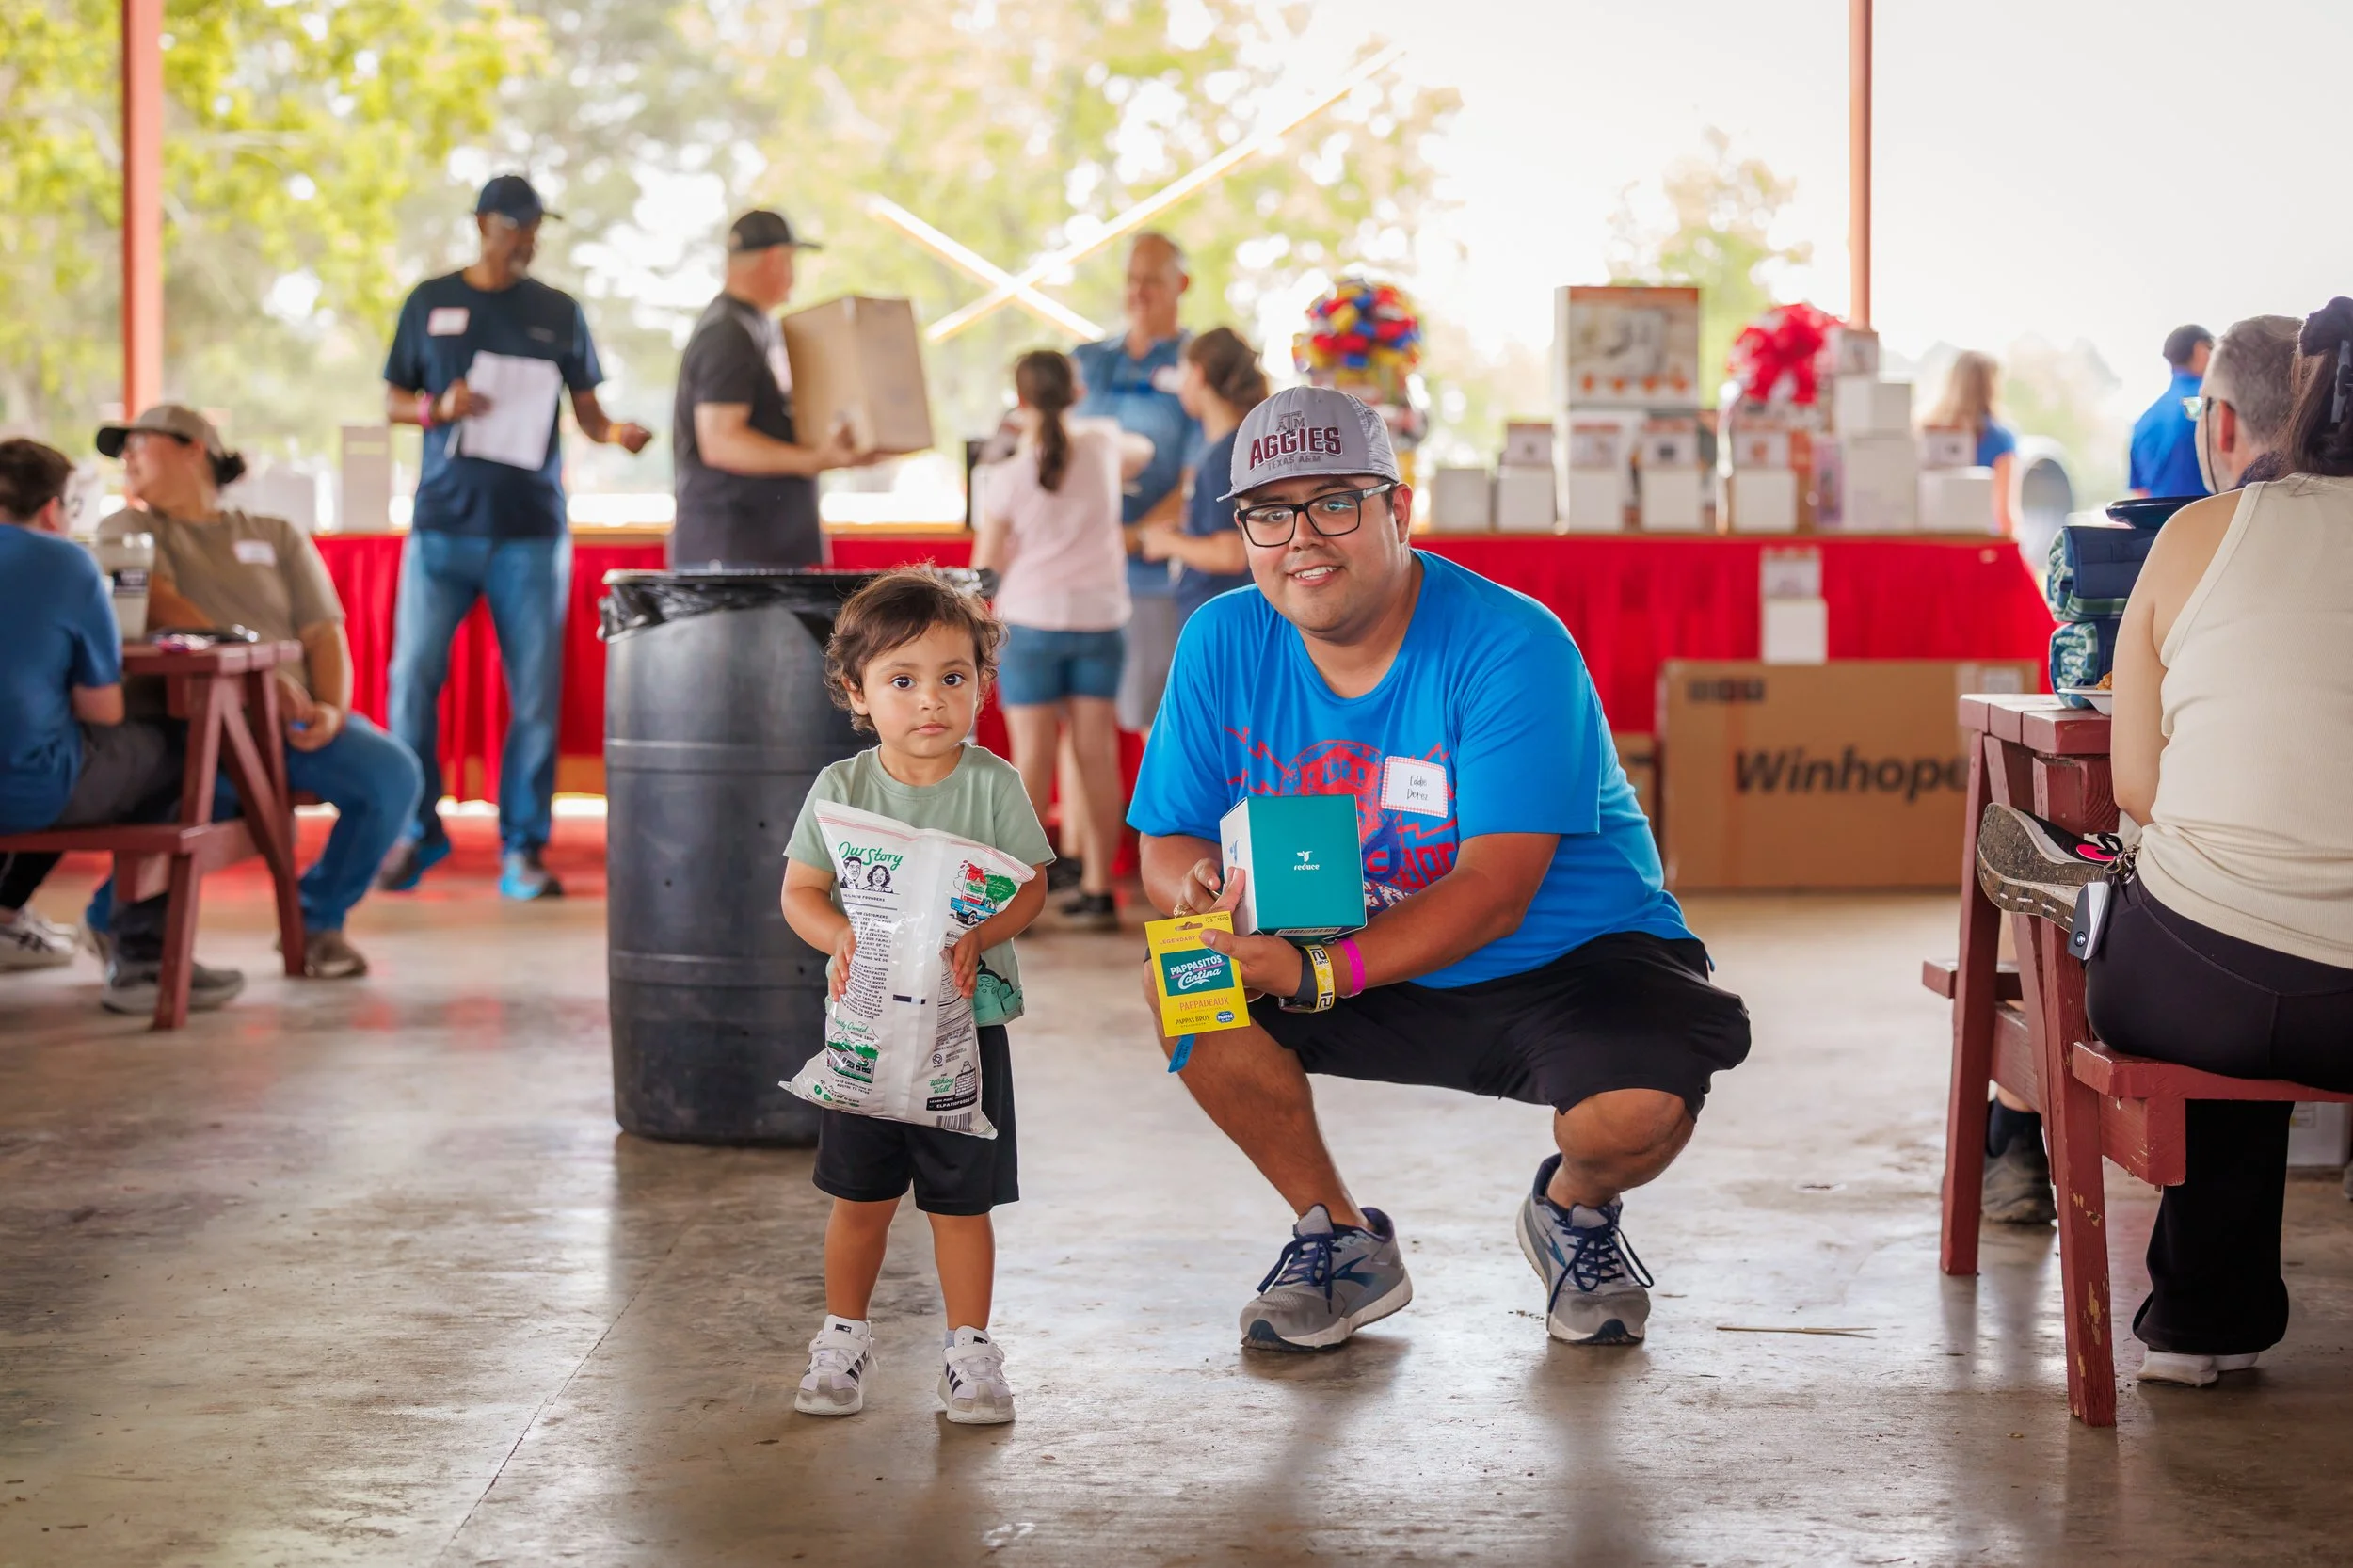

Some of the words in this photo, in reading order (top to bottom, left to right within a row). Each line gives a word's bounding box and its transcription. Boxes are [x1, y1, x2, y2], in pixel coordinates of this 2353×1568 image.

[1249, 426, 1342, 472] AGGIES
[1268, 456, 1295, 471] TEXAS
[838, 841, 867, 858] Our
[862, 847, 904, 871] Story
[1159, 936, 1195, 945] LEGENDARY
[1170, 954, 1223, 976] PAPPASITO'S
[1177, 968, 1222, 990] Cantina
[1179, 997, 1229, 1012] PAPPADEAUX
[929, 1078, 955, 1088] Wishing
[934, 1085, 951, 1094] Well
